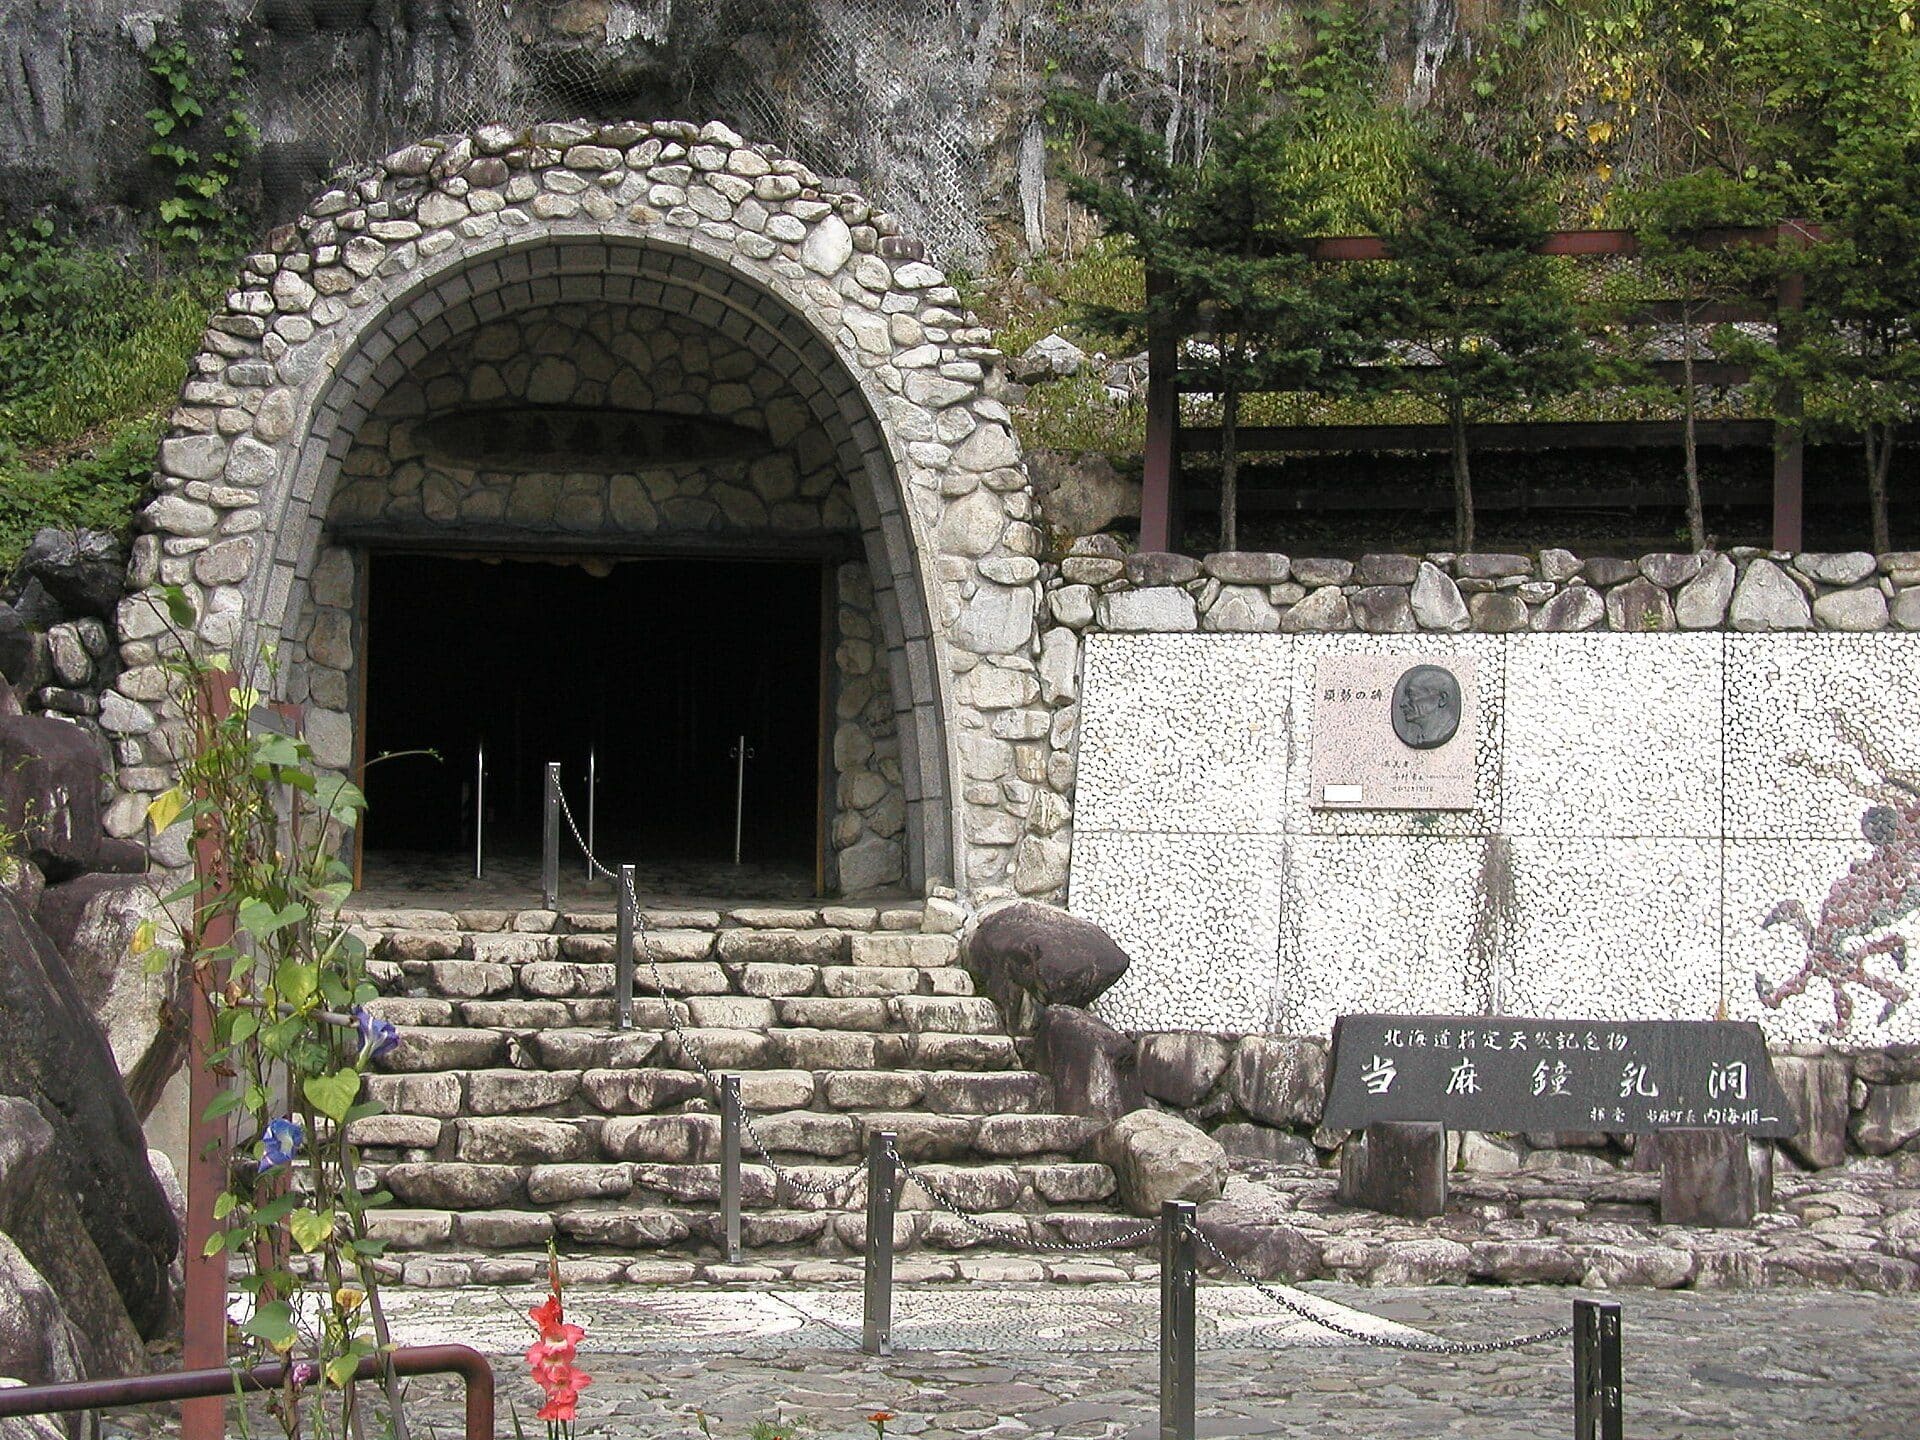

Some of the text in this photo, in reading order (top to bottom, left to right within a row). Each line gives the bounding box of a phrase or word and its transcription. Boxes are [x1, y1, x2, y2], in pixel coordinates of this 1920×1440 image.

[1383, 1028, 1628, 1051] 北海道指定天然記念物
[1360, 1054, 1748, 1099] 当麻鐘乳洞
